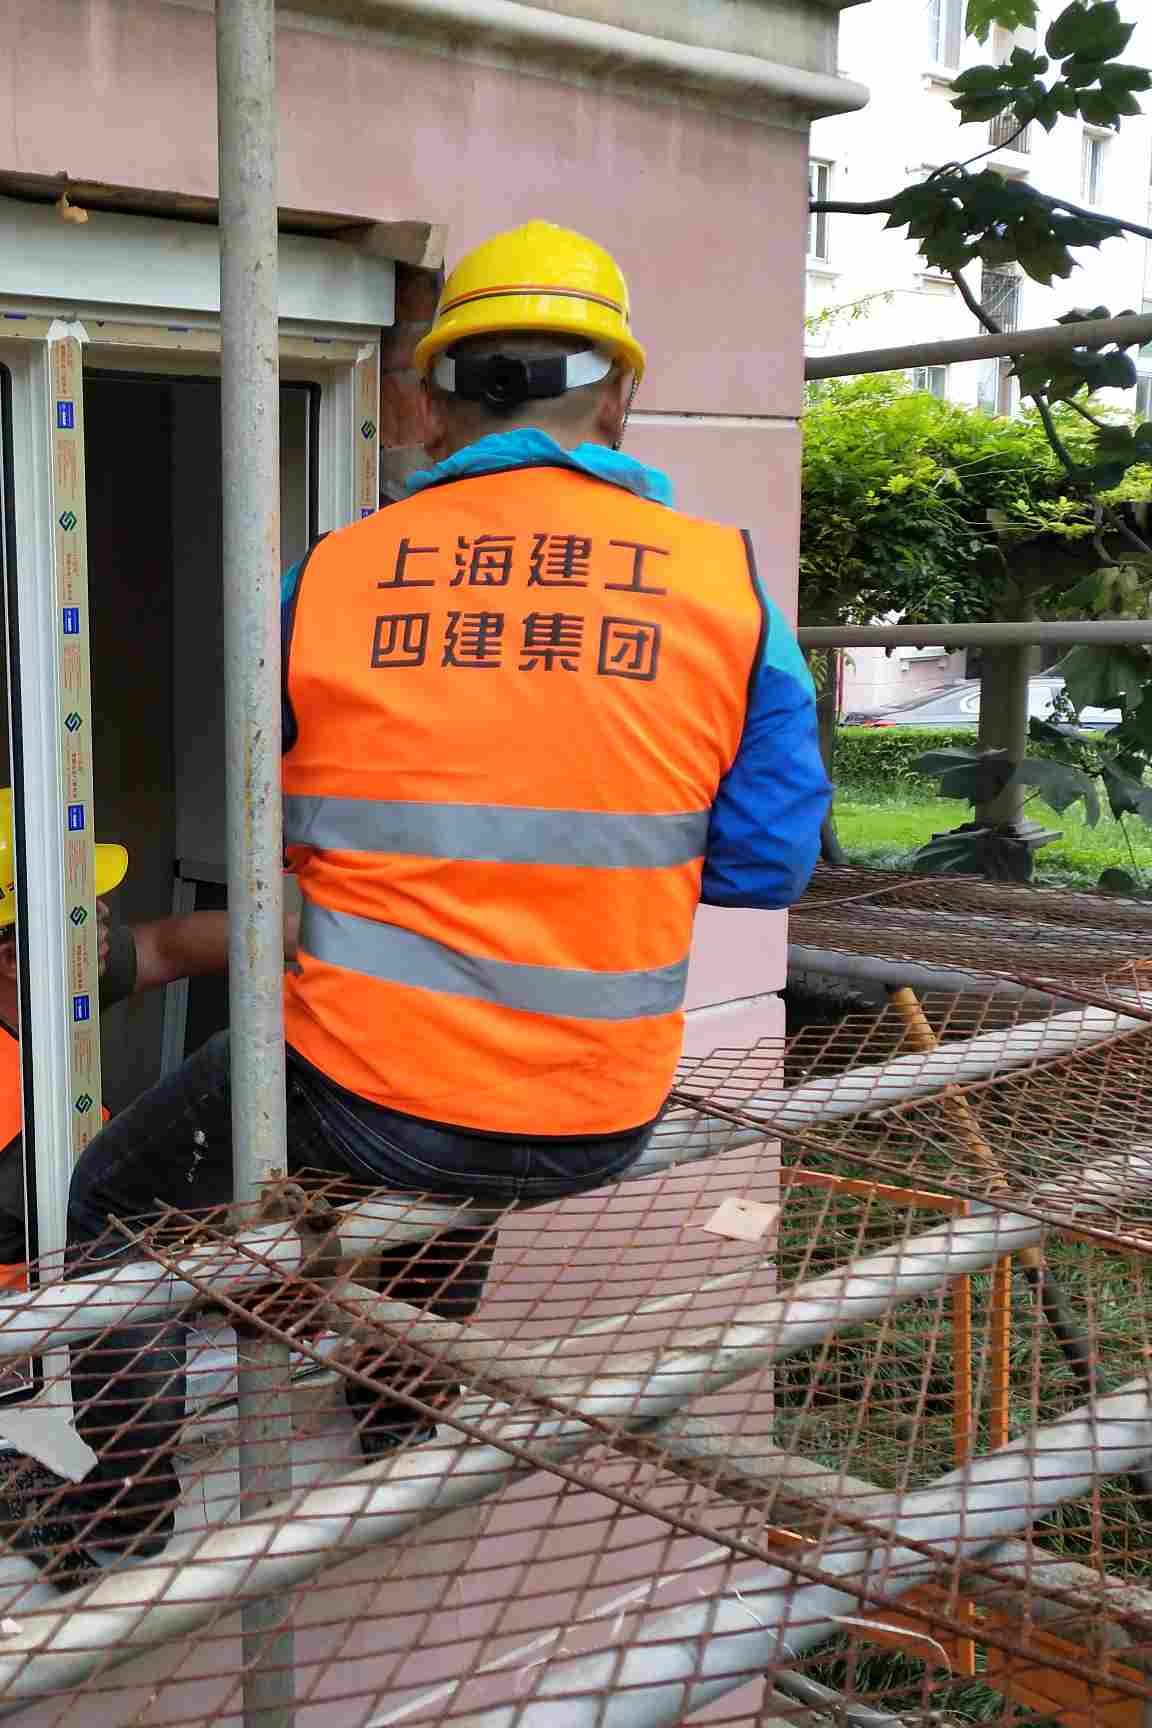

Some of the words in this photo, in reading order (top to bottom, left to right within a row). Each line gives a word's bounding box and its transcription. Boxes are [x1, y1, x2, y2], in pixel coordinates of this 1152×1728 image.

[376, 533, 672, 597] 上海建工
[369, 611, 662, 682] 四建集团
